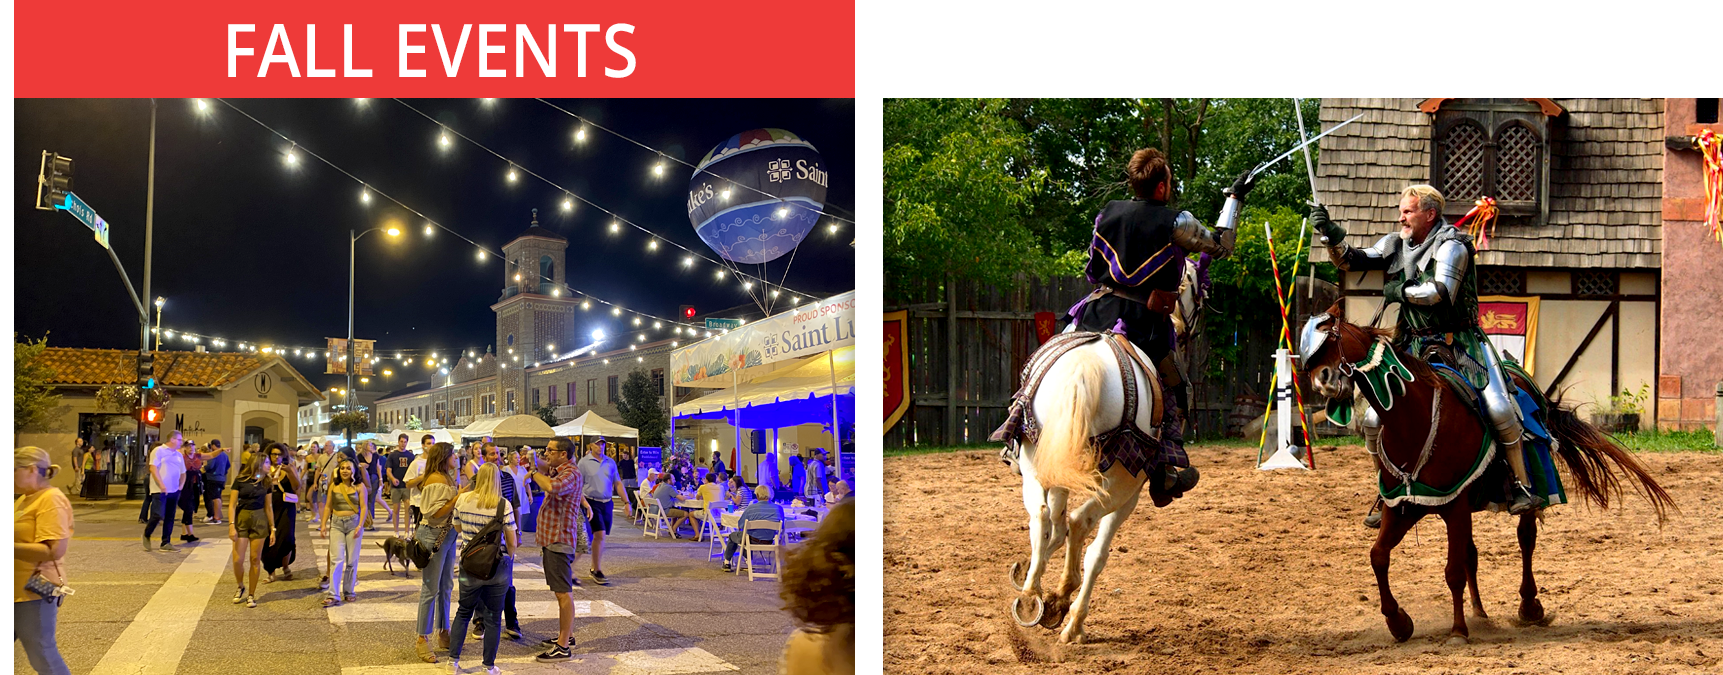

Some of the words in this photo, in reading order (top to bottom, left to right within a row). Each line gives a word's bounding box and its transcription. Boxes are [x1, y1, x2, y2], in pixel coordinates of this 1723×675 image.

[796, 159, 829, 188] Saint
[86, 211, 93, 224] Rd
[708, 320, 738, 329] Broadway
[793, 309, 818, 325] PROUD
[781, 322, 832, 354] Saint
[175, 413, 206, 437] Matches
[399, 456, 408, 467] H
